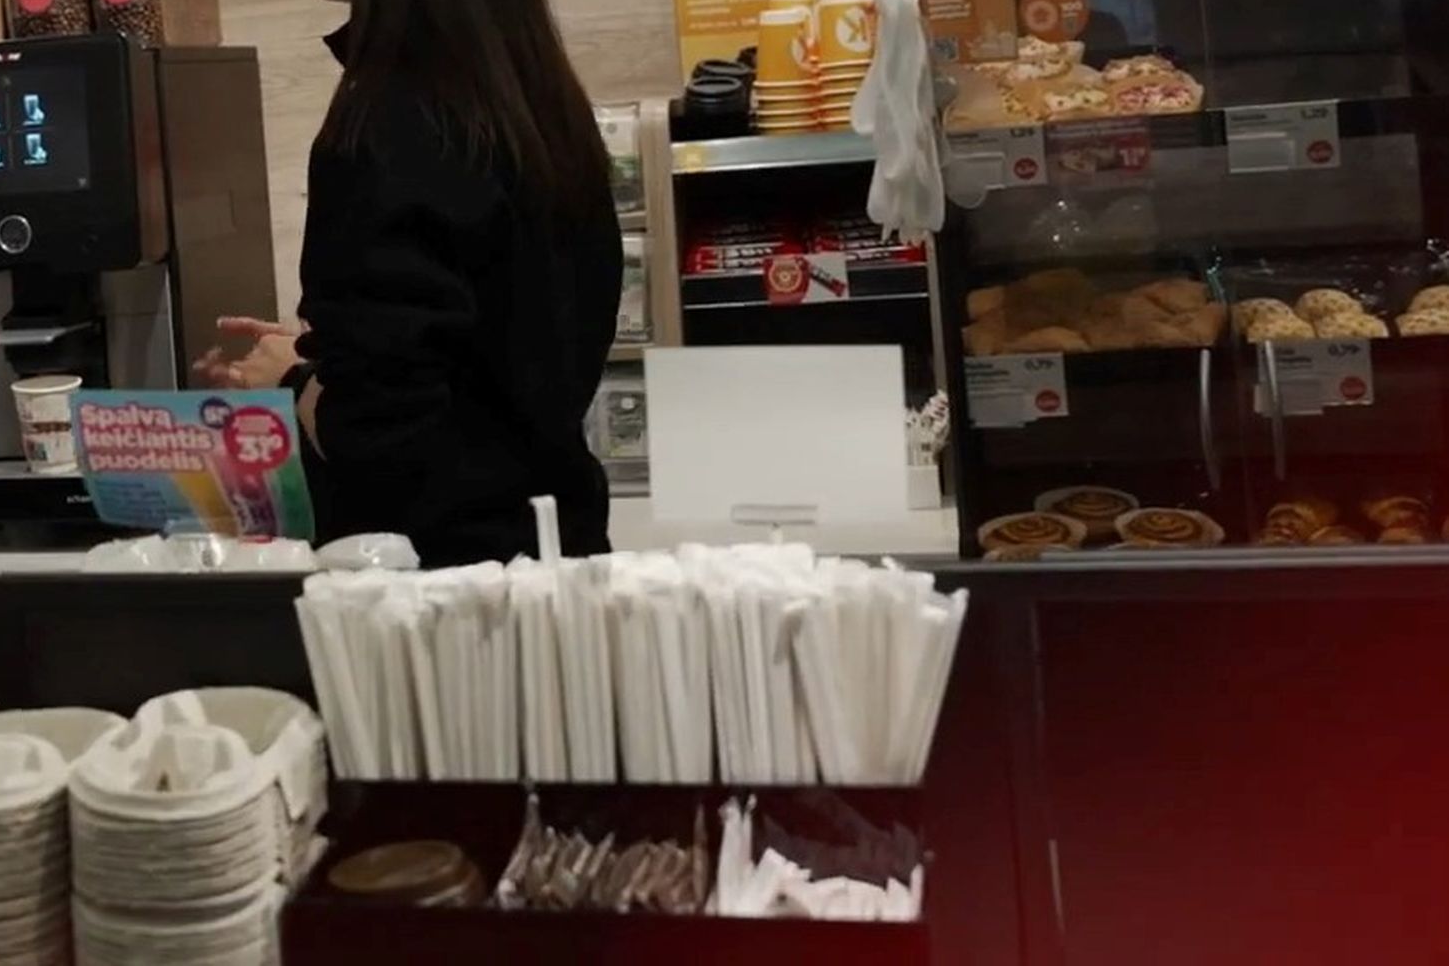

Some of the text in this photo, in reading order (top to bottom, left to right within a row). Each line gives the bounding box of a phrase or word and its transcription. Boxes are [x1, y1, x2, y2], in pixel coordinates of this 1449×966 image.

[81, 403, 173, 430] Spalva
[83, 425, 214, 451] keičiantis
[88, 449, 205, 474] puodelis
